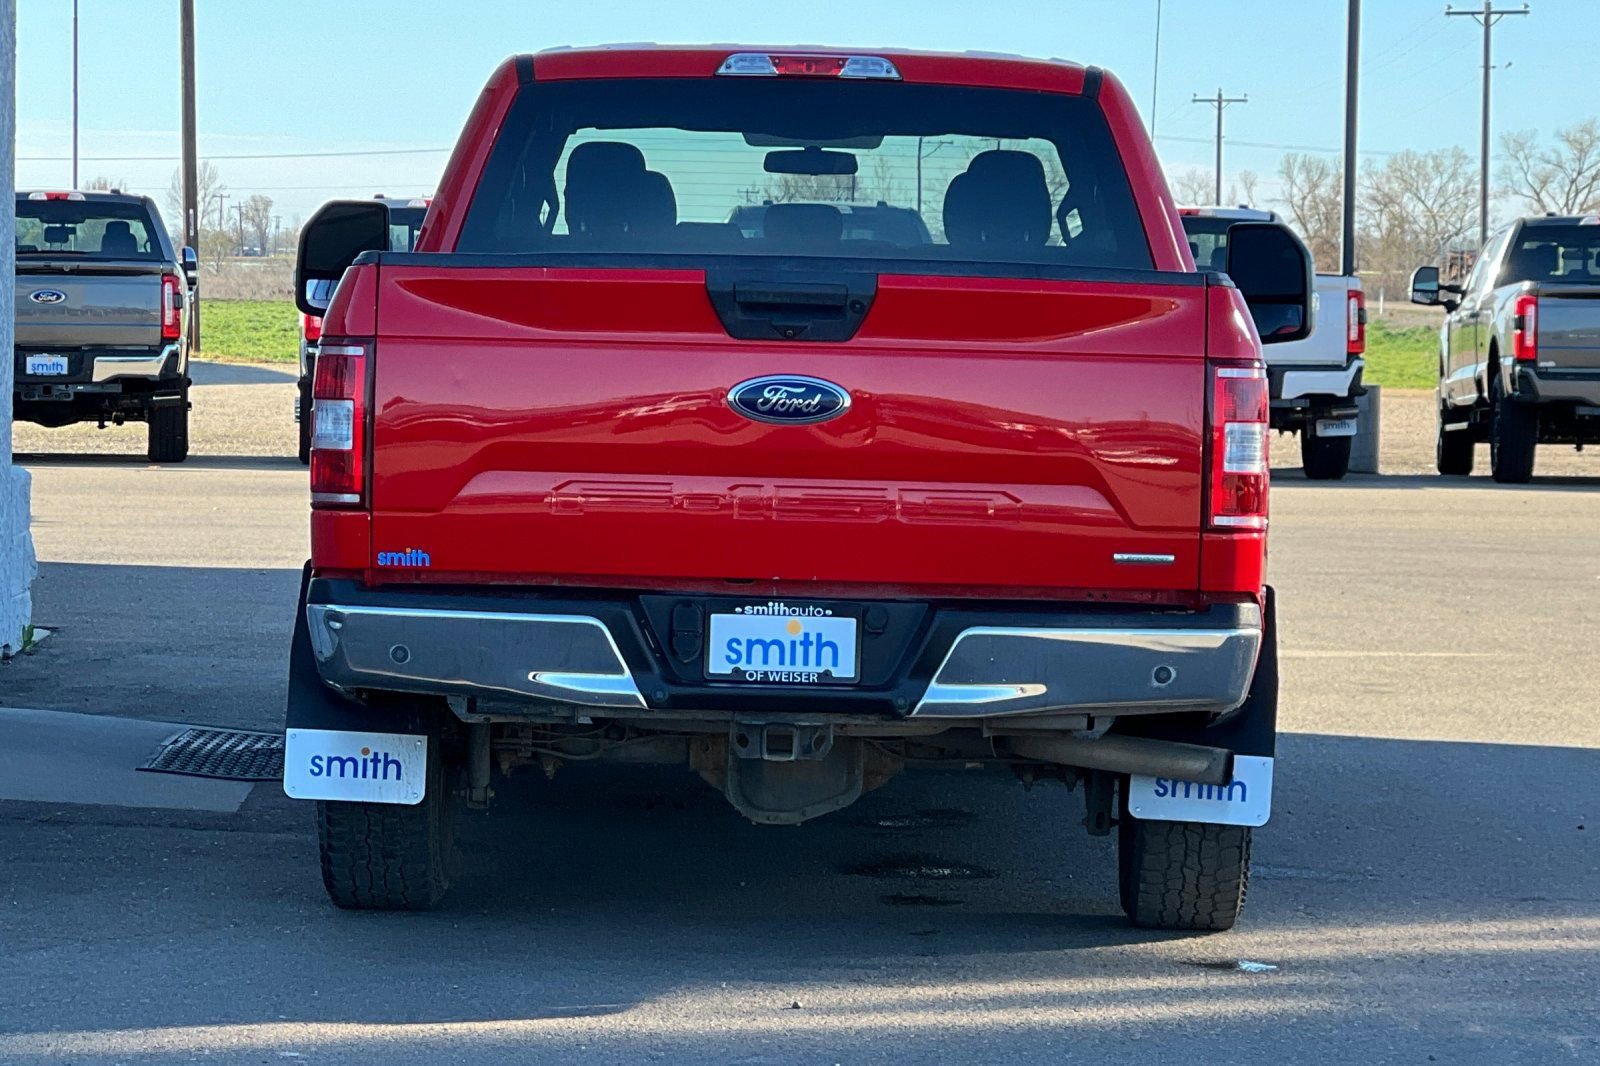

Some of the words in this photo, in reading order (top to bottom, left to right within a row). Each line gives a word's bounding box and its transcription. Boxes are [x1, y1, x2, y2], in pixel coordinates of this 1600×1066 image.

[31, 357, 64, 372] smith
[756, 384, 823, 413] Ford
[377, 547, 431, 567] smith
[744, 601, 824, 617] smithauto
[725, 619, 839, 668] smith
[745, 670, 765, 682] OF
[768, 671, 819, 684] WEISER
[309, 747, 402, 781] smith
[1154, 774, 1248, 803] smh
